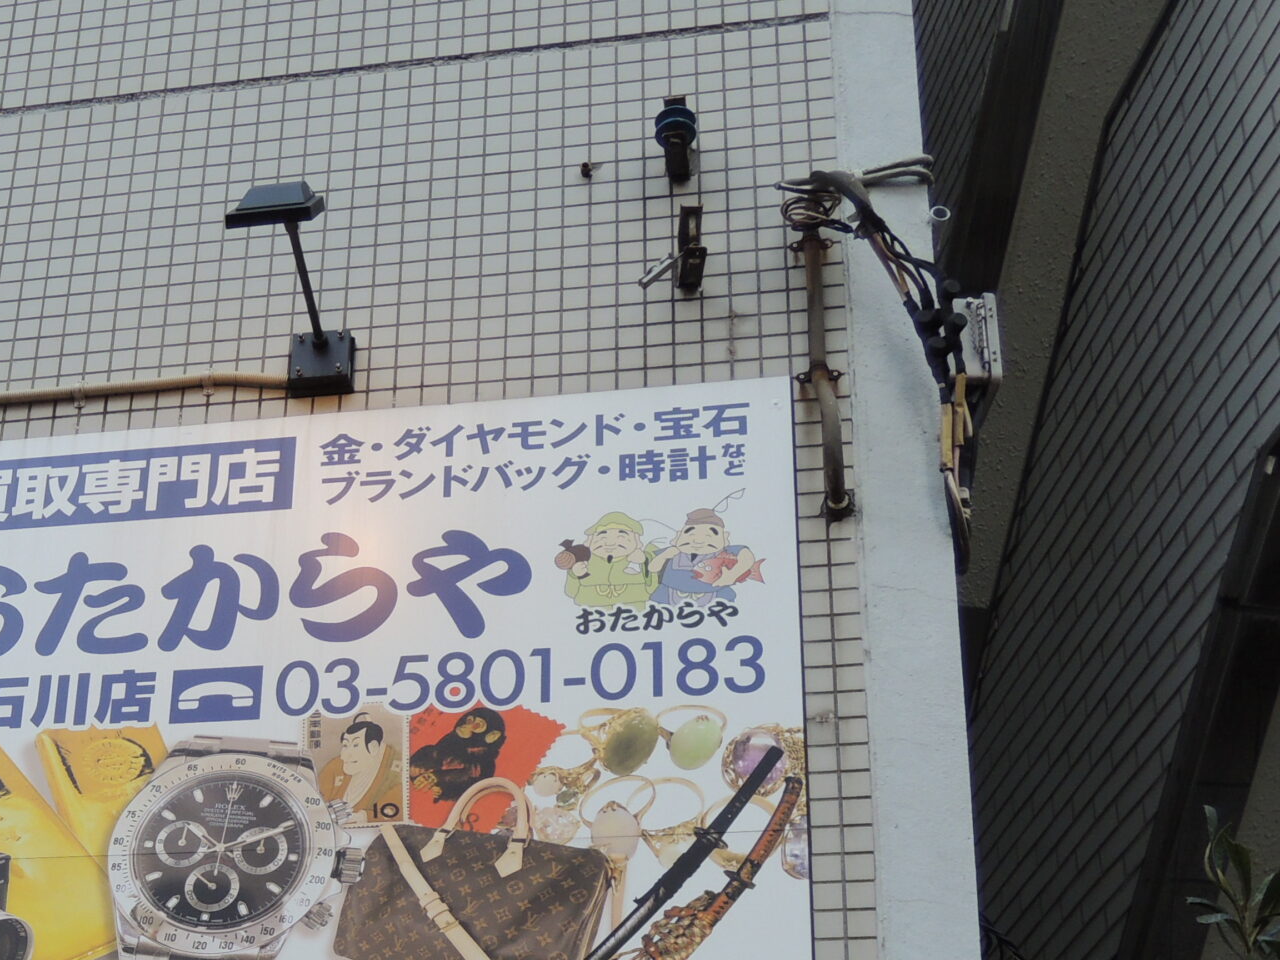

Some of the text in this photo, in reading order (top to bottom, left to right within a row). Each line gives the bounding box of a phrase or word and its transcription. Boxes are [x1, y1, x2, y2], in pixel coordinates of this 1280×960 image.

[575, 602, 739, 635] おたからや
[276, 635, 766, 717] 03-5801-0183
[304, 796, 321, 806] 400
[372, 802, 400, 819] 10
[315, 821, 331, 831] 300
